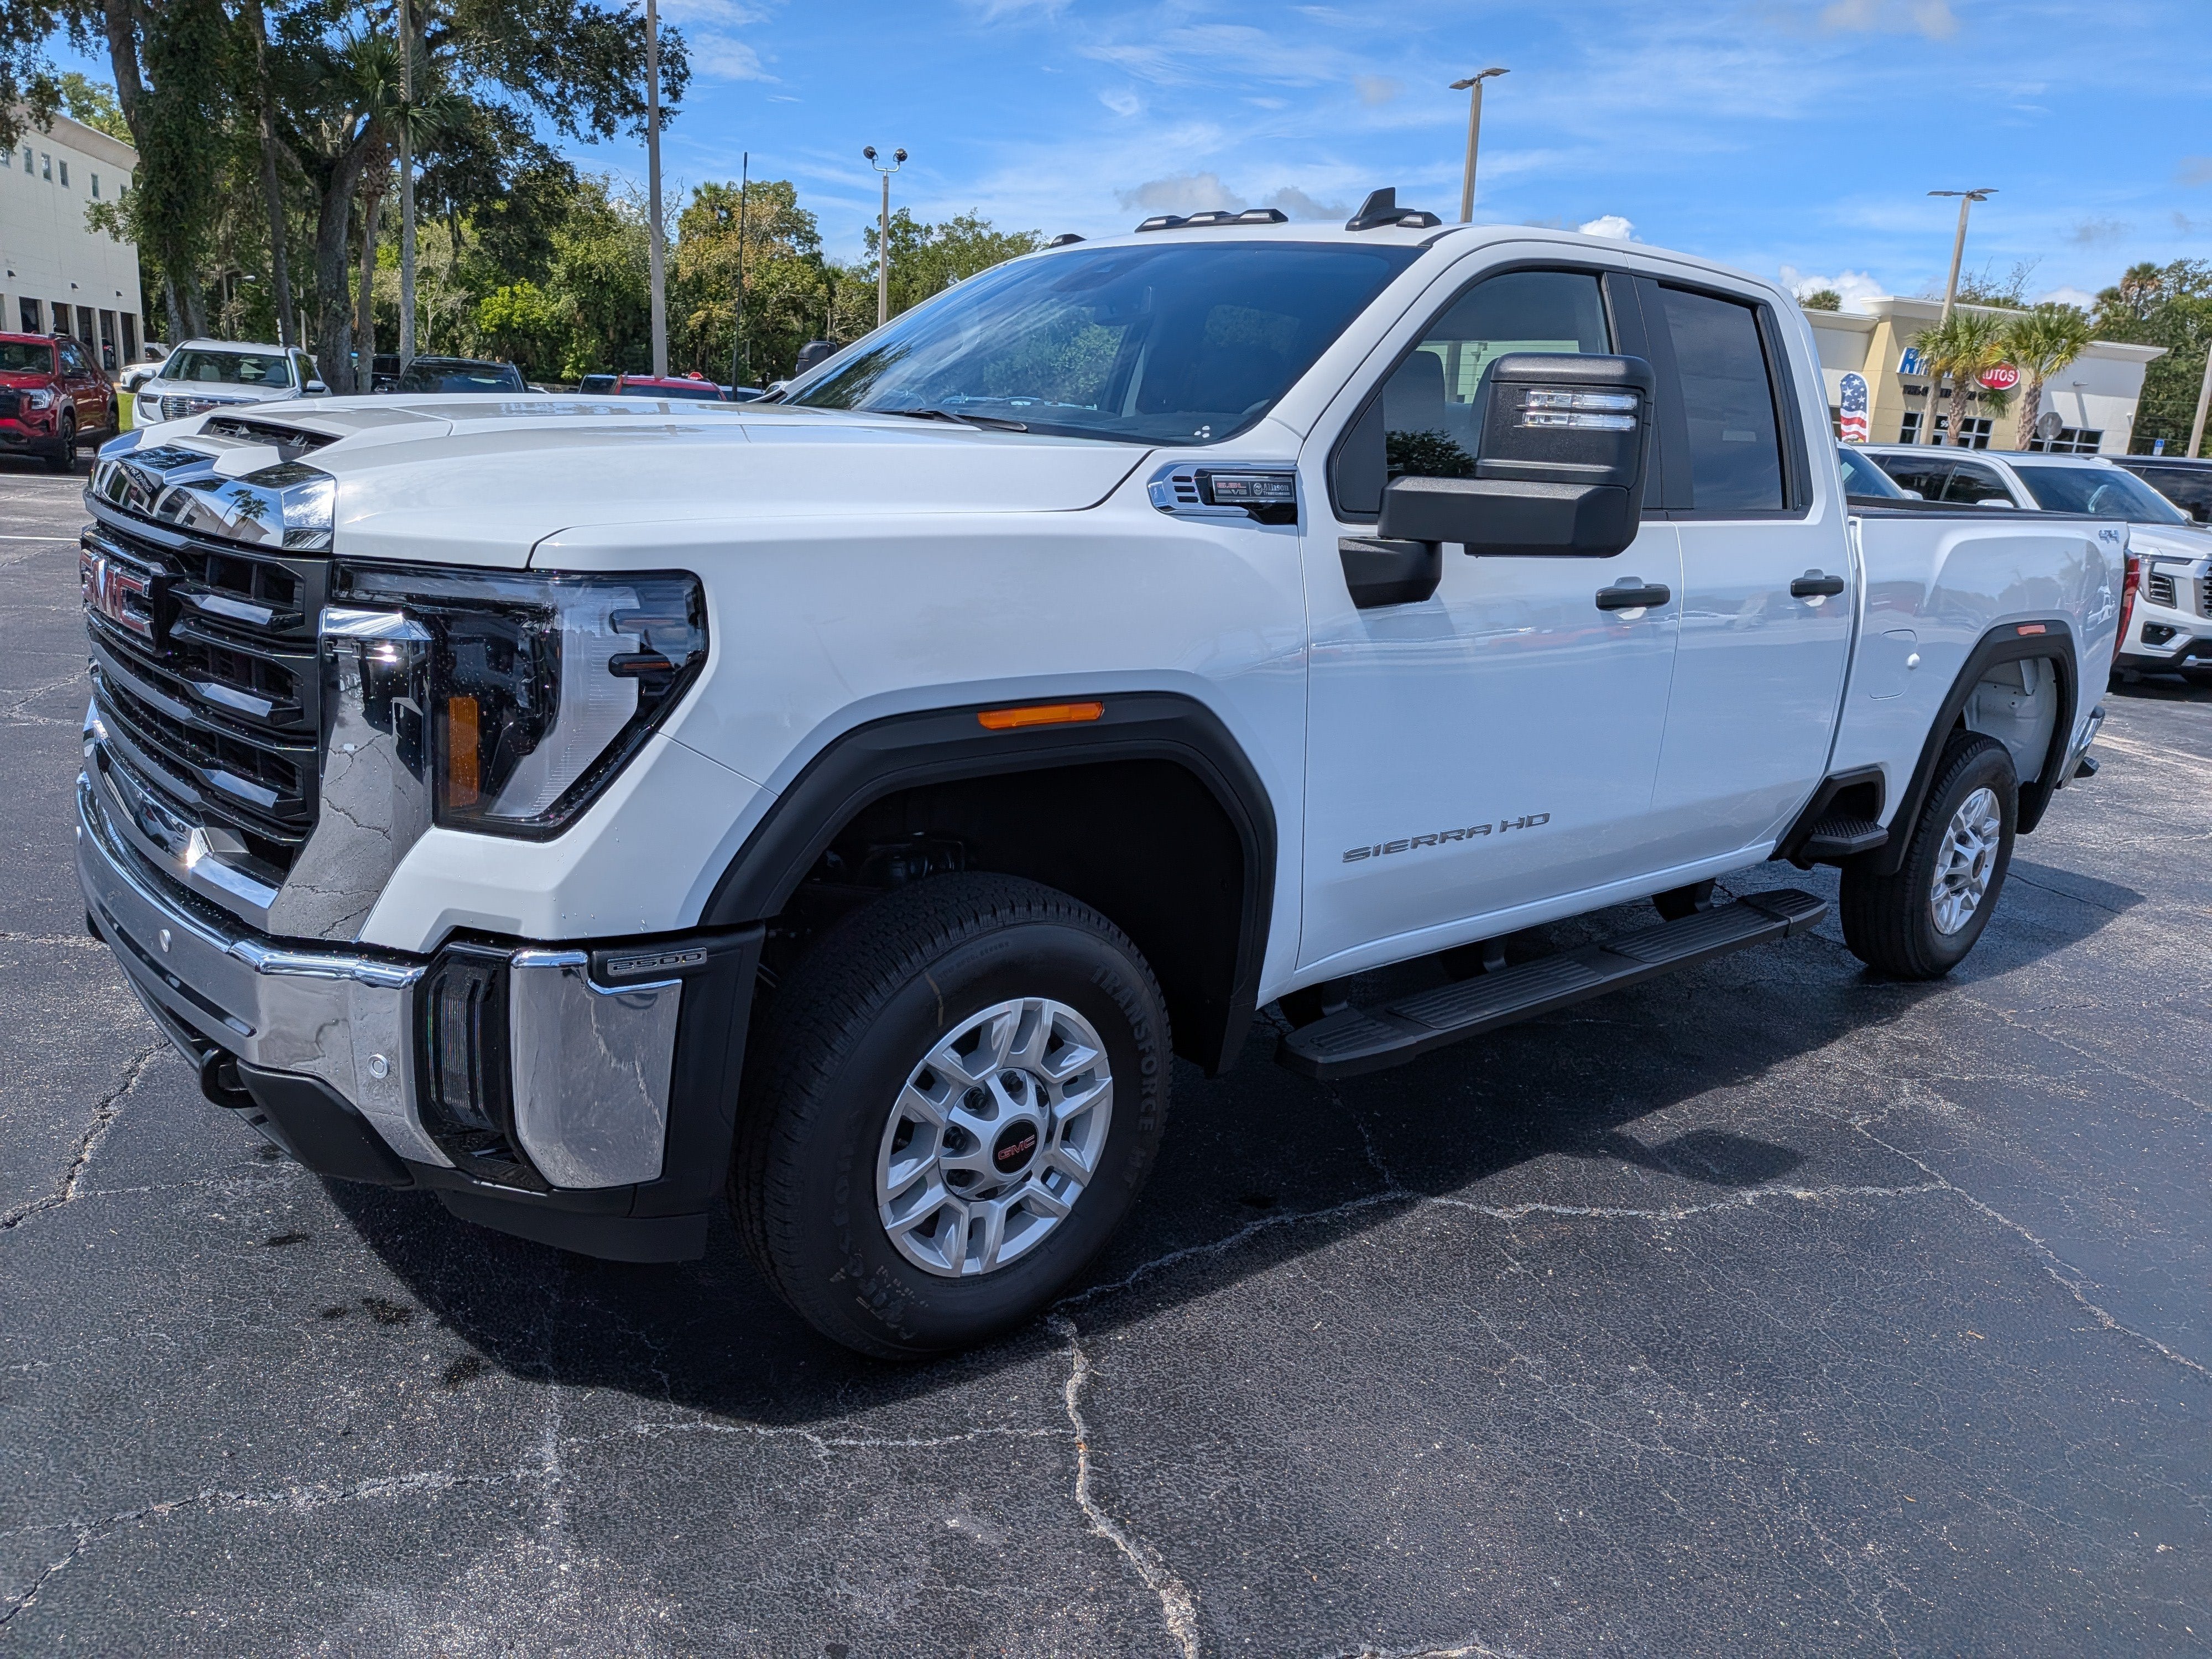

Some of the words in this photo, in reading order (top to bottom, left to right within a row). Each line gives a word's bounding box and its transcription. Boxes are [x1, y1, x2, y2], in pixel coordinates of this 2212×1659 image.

[1983, 368, 2016, 382] UTOS
[1263, 483, 1290, 491] Allison
[79, 549, 153, 640] GMC
[1342, 822, 1493, 863] SIERRA
[1499, 812, 1551, 833] HD
[613, 953, 702, 971] 2500
[1089, 961, 1159, 1132] TRANSFORCE
[998, 1134, 1035, 1160] GMC
